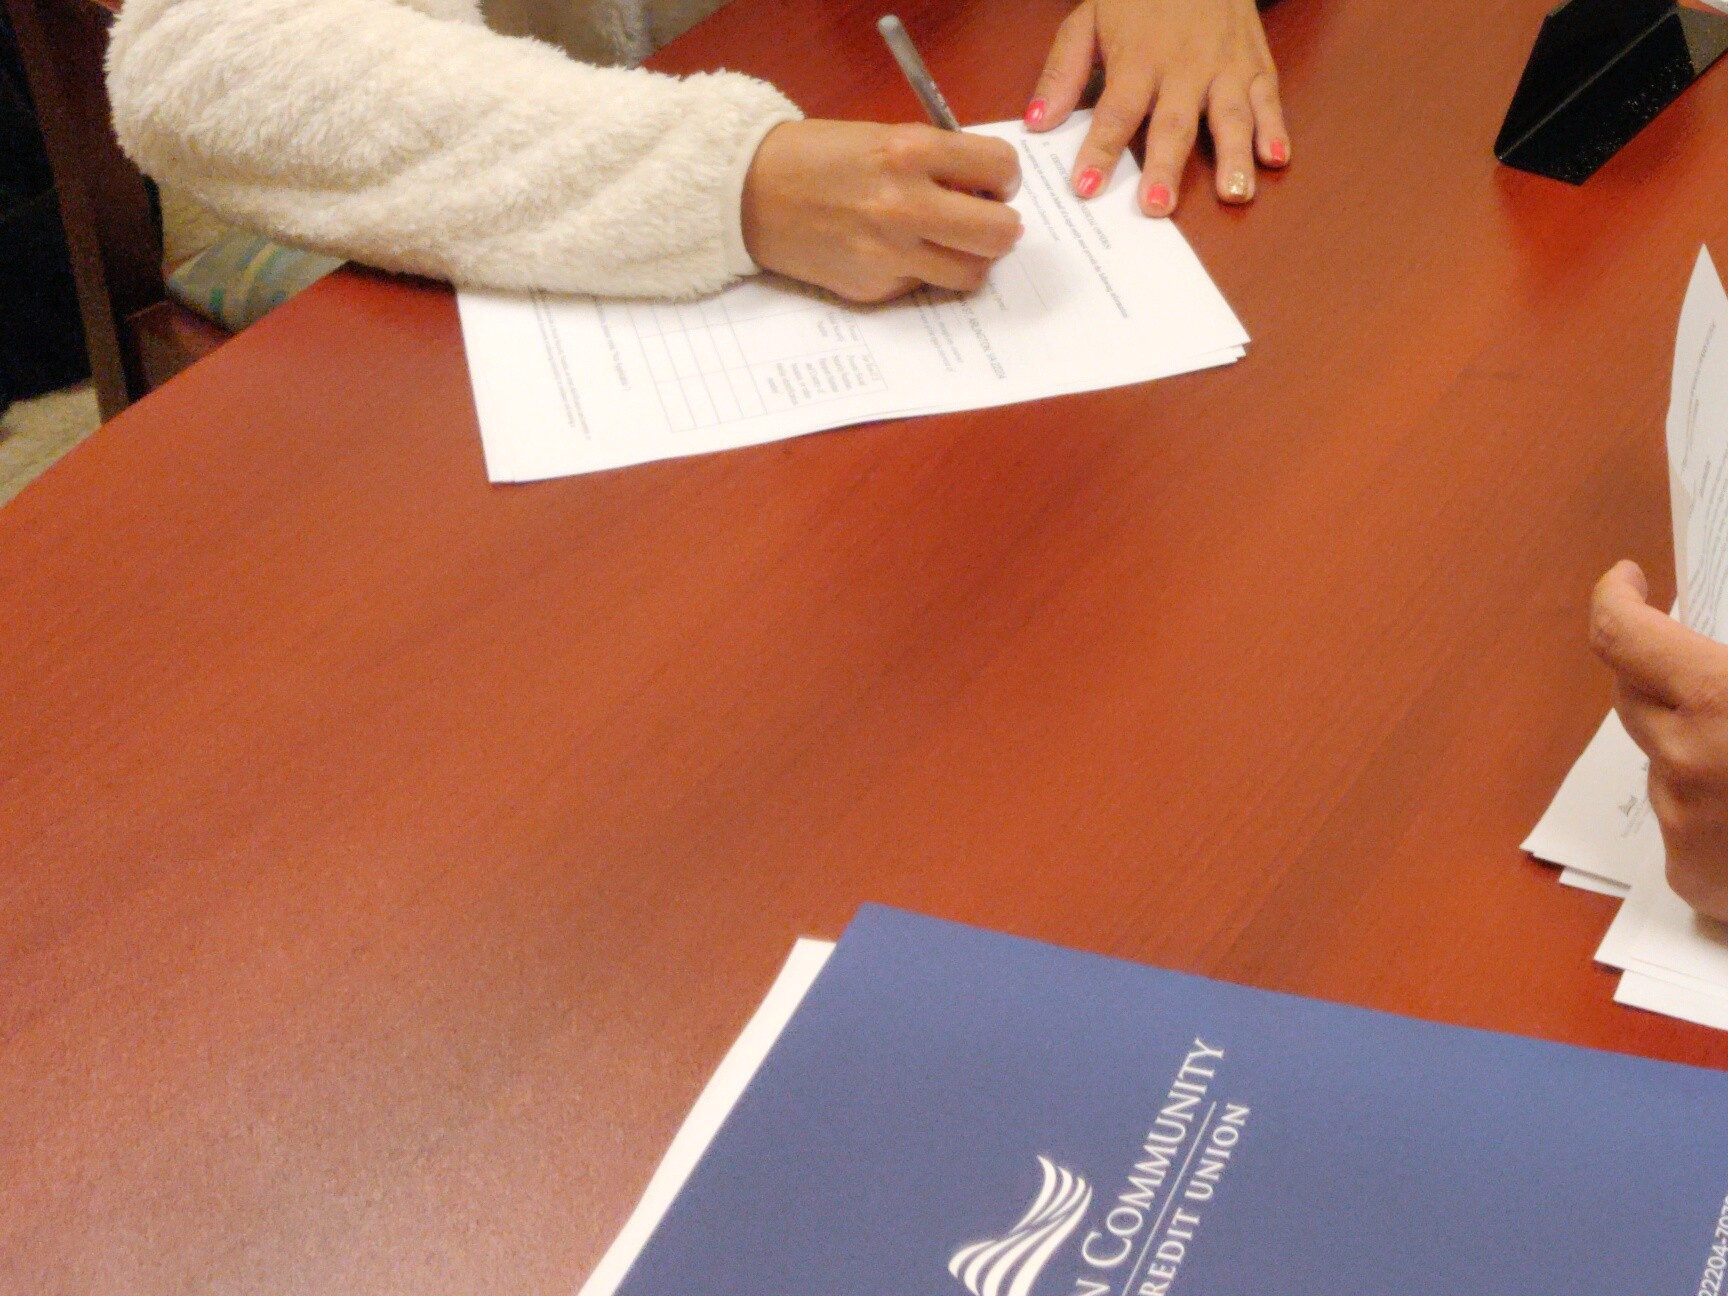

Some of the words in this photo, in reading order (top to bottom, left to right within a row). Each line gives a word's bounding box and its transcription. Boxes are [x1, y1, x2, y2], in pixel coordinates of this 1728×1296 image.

[1081, 1036, 1226, 1269] COMMUNITY
[1137, 1207, 1201, 1296] REDIT
[1183, 1102, 1251, 1202] UNION
